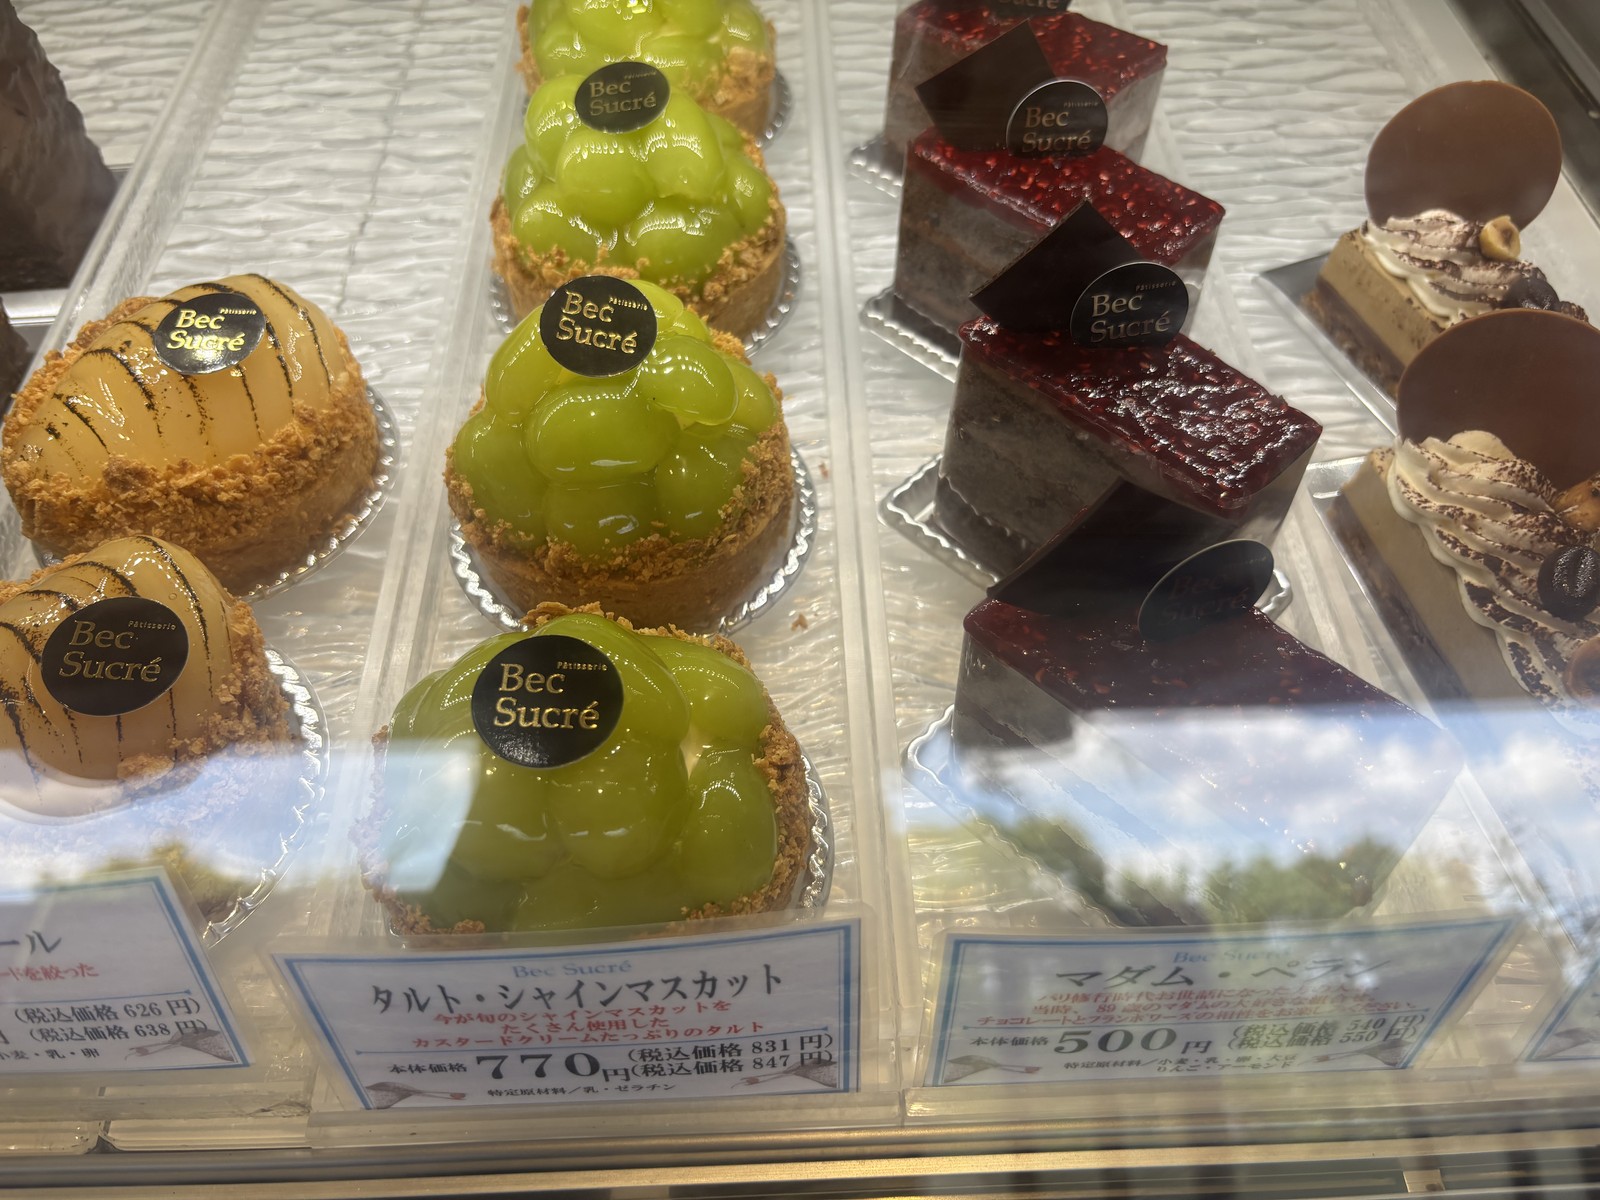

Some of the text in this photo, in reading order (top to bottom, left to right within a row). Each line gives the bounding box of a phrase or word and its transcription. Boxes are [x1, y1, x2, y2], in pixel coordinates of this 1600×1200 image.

[589, 81, 631, 98] Bec
[590, 92, 657, 116] Sucré
[1025, 107, 1069, 128] Bec
[1022, 129, 1092, 153] Sucré
[561, 290, 615, 322] Bec
[1091, 294, 1143, 317] Bec
[175, 308, 226, 330] Bec
[1090, 310, 1170, 343] Sucré
[166, 329, 246, 352] Sucré
[556, 315, 638, 354] Sucré
[68, 619, 135, 649] Bec
[58, 650, 163, 682] Sucré
[498, 663, 566, 694] Bec
[493, 696, 600, 729] Sucré
[512, 960, 632, 979] Bec Sucré
[1055, 958, 1392, 990] マダム・ペラン
[372, 963, 782, 1014] タルト・シャインマスカット
[124, 1003, 162, 1018] 626
[167, 997, 201, 1016] 円)
[433, 1000, 732, 1025] 今が旬のシャインマスカットを
[134, 1023, 171, 1038] 638
[175, 1019, 208, 1036] 円)
[411, 1021, 765, 1048] カスタードクリームたっぷりのタルト
[502, 1016, 669, 1035] たくさん使用した
[1346, 1018, 1386, 1030] 540
[752, 1036, 790, 1054] 831
[799, 1032, 834, 1050] 円)
[1053, 1028, 1178, 1054] 500
[1339, 1030, 1378, 1043] 550
[475, 1051, 601, 1080] 770
[753, 1054, 790, 1069] 847
[800, 1050, 833, 1067] 円)
